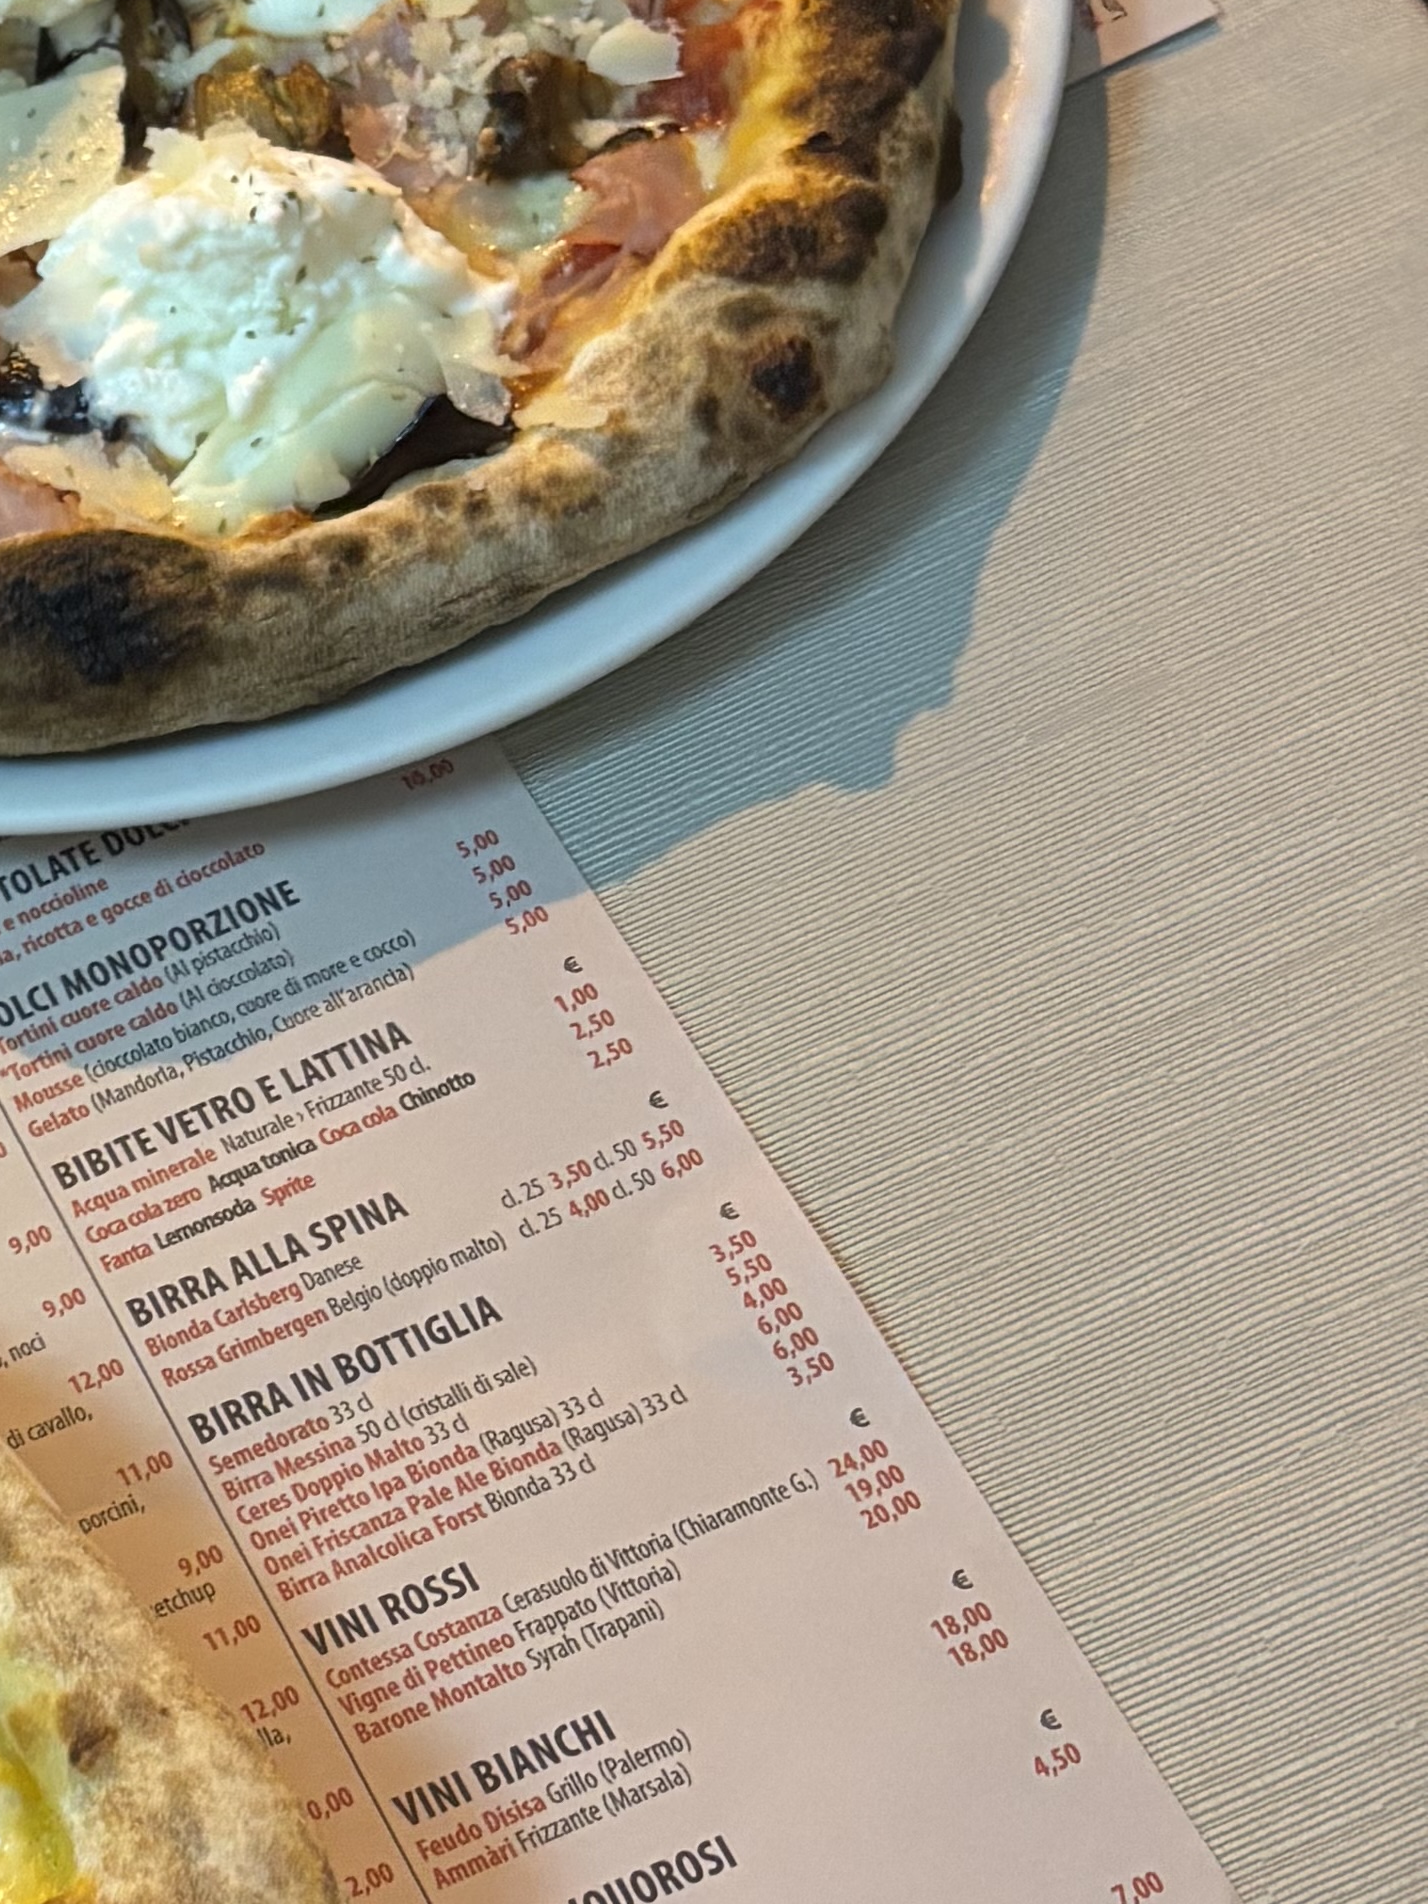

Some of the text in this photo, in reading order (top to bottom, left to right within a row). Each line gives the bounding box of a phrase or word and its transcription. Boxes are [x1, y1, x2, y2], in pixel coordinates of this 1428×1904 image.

[59, 878, 302, 1001] MONOPORZIONE
[50, 1020, 413, 1191] BIBITE VETRO E LATTINA
[124, 1190, 410, 1328] BIRRA ALLA SPINA
[7, 1330, 47, 1362] noci
[186, 1294, 504, 1445] BIRRA IN BOTTIGLIA
[844, 1463, 906, 1503] 19,00
[858, 1489, 922, 1530] 20,00
[299, 1560, 481, 1656] VINI ROSSI
[336, 1557, 683, 1716] Vigne di Pettineo Frappato (Vittoria)
[929, 1601, 993, 1641] 18,00
[946, 1627, 1010, 1667] 18,00
[352, 1597, 666, 1744] Barone Montalto Syrah (Trapani)
[390, 1708, 617, 1826] VINI BIANCHI
[415, 1727, 693, 1862] Feudo Disisa Grillo (Palermo)
[514, 1804, 604, 1853] Frizzante
[601, 1760, 693, 1818] (Marsala)
